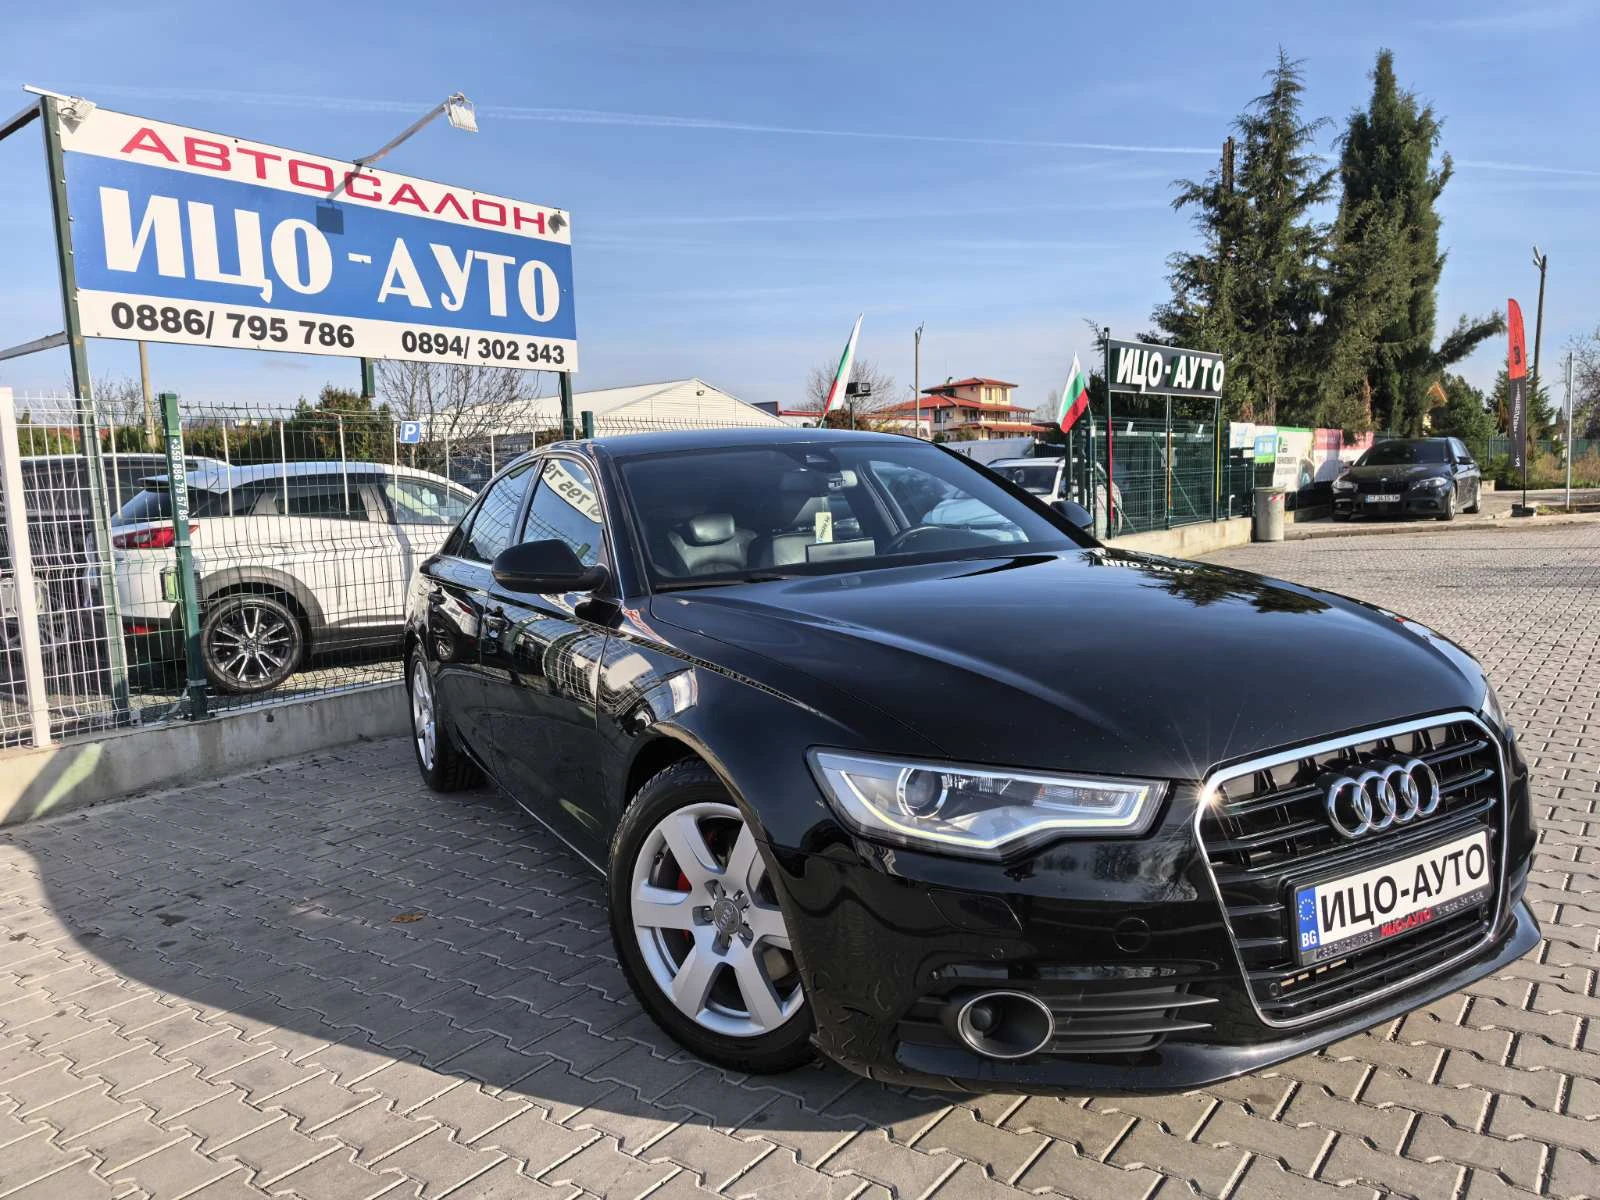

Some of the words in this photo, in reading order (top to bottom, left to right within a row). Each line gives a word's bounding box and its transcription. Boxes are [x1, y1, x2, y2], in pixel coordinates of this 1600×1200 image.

[121, 127, 546, 234] АВТОСАЛОН
[111, 301, 215, 339] 0886/
[226, 312, 288, 343] 795
[299, 320, 355, 349] 786
[401, 330, 470, 359] 0894/
[477, 337, 520, 361] 302
[526, 342, 565, 365] 343
[404, 423, 417, 441] P
[171, 438, 182, 460] +359
[172, 463, 184, 480] 886
[175, 482, 185, 494] 79
[1321, 843, 1485, 933] ИЦО-АУТО
[1302, 930, 1317, 947] BG
